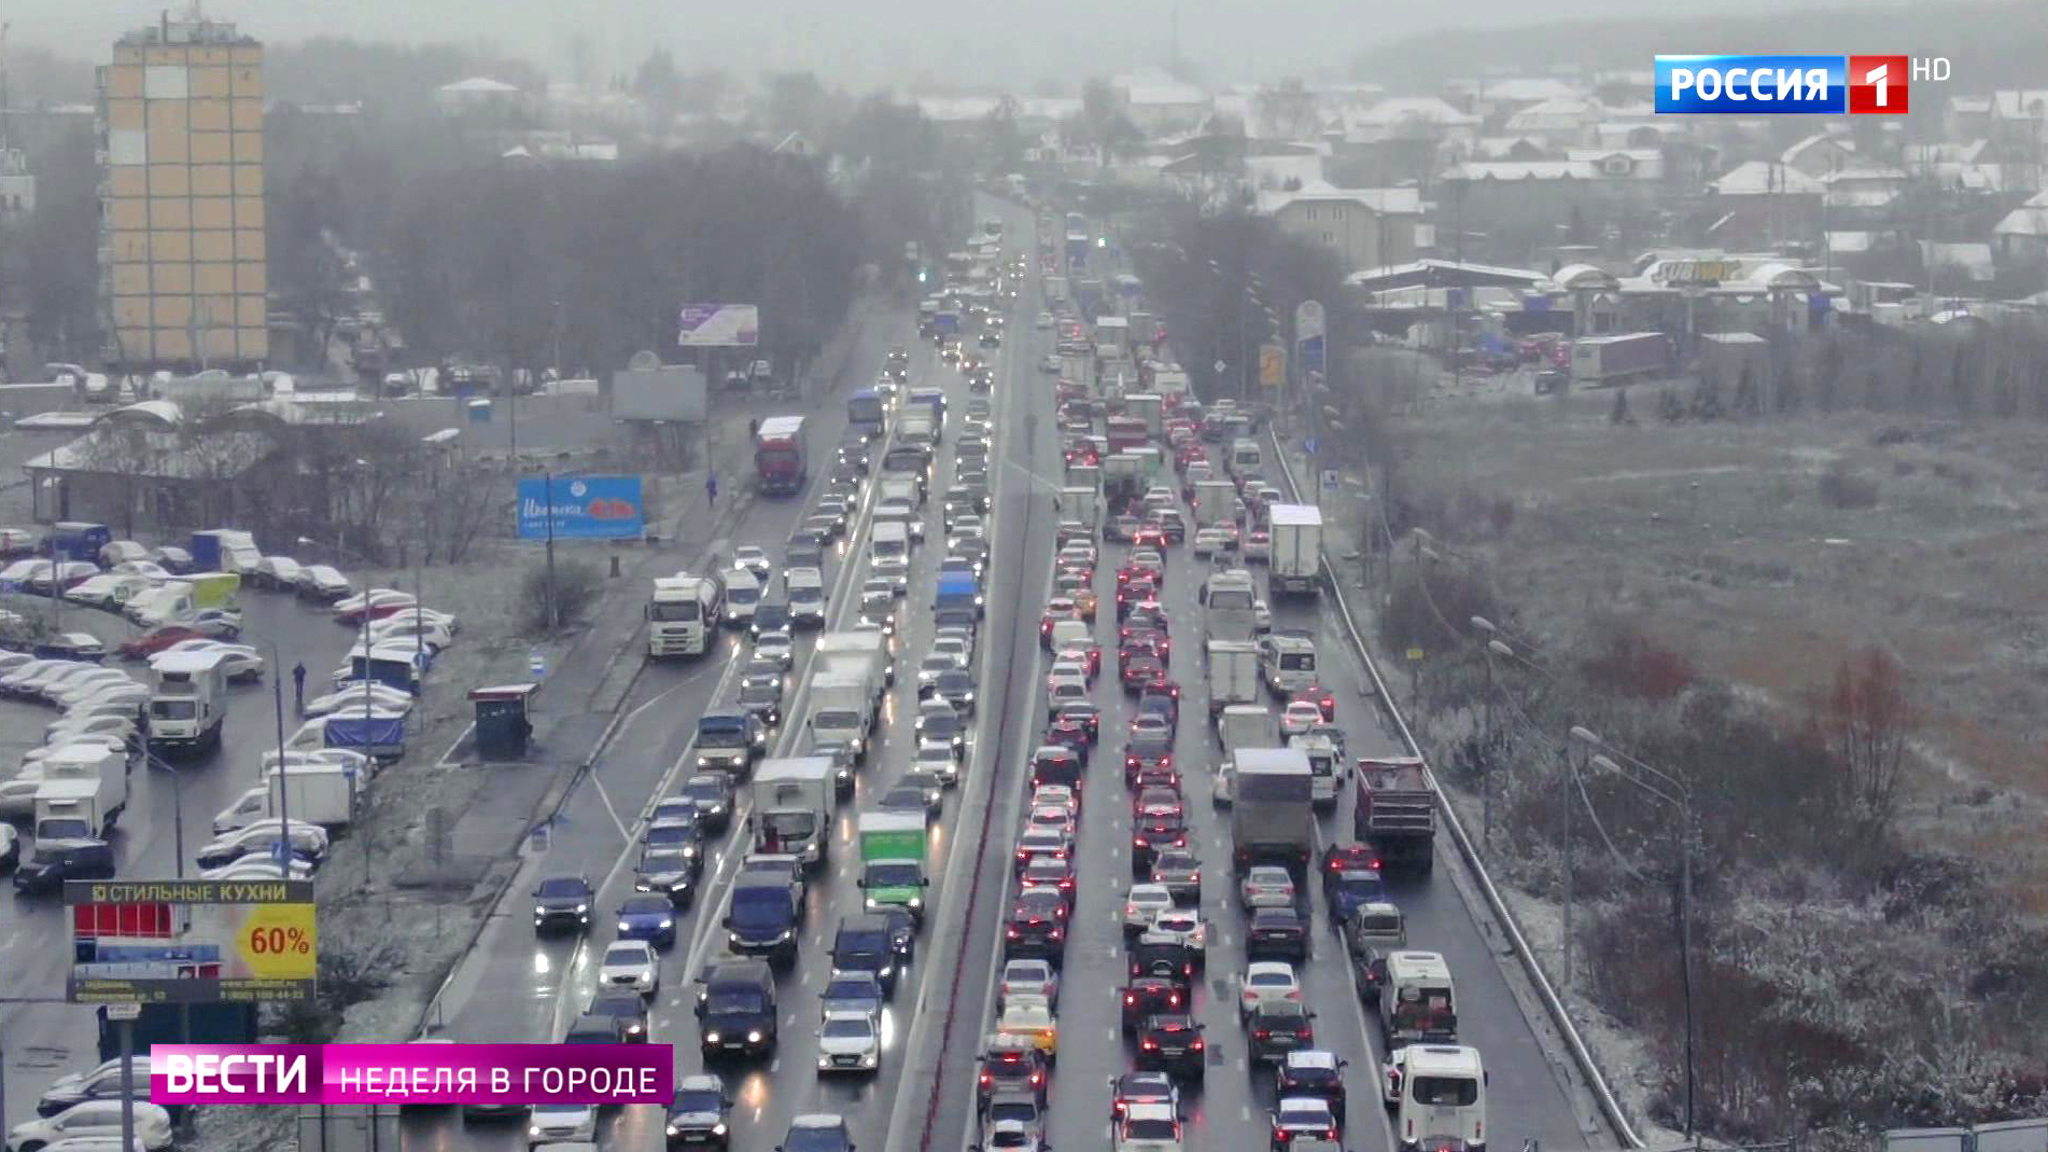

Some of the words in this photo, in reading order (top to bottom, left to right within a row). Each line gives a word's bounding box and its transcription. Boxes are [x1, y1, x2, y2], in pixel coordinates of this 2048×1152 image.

[110, 886, 213, 901] СТИЛЬНЫЕ
[220, 886, 287, 901] КУХНИ
[250, 927, 310, 954] 60%
